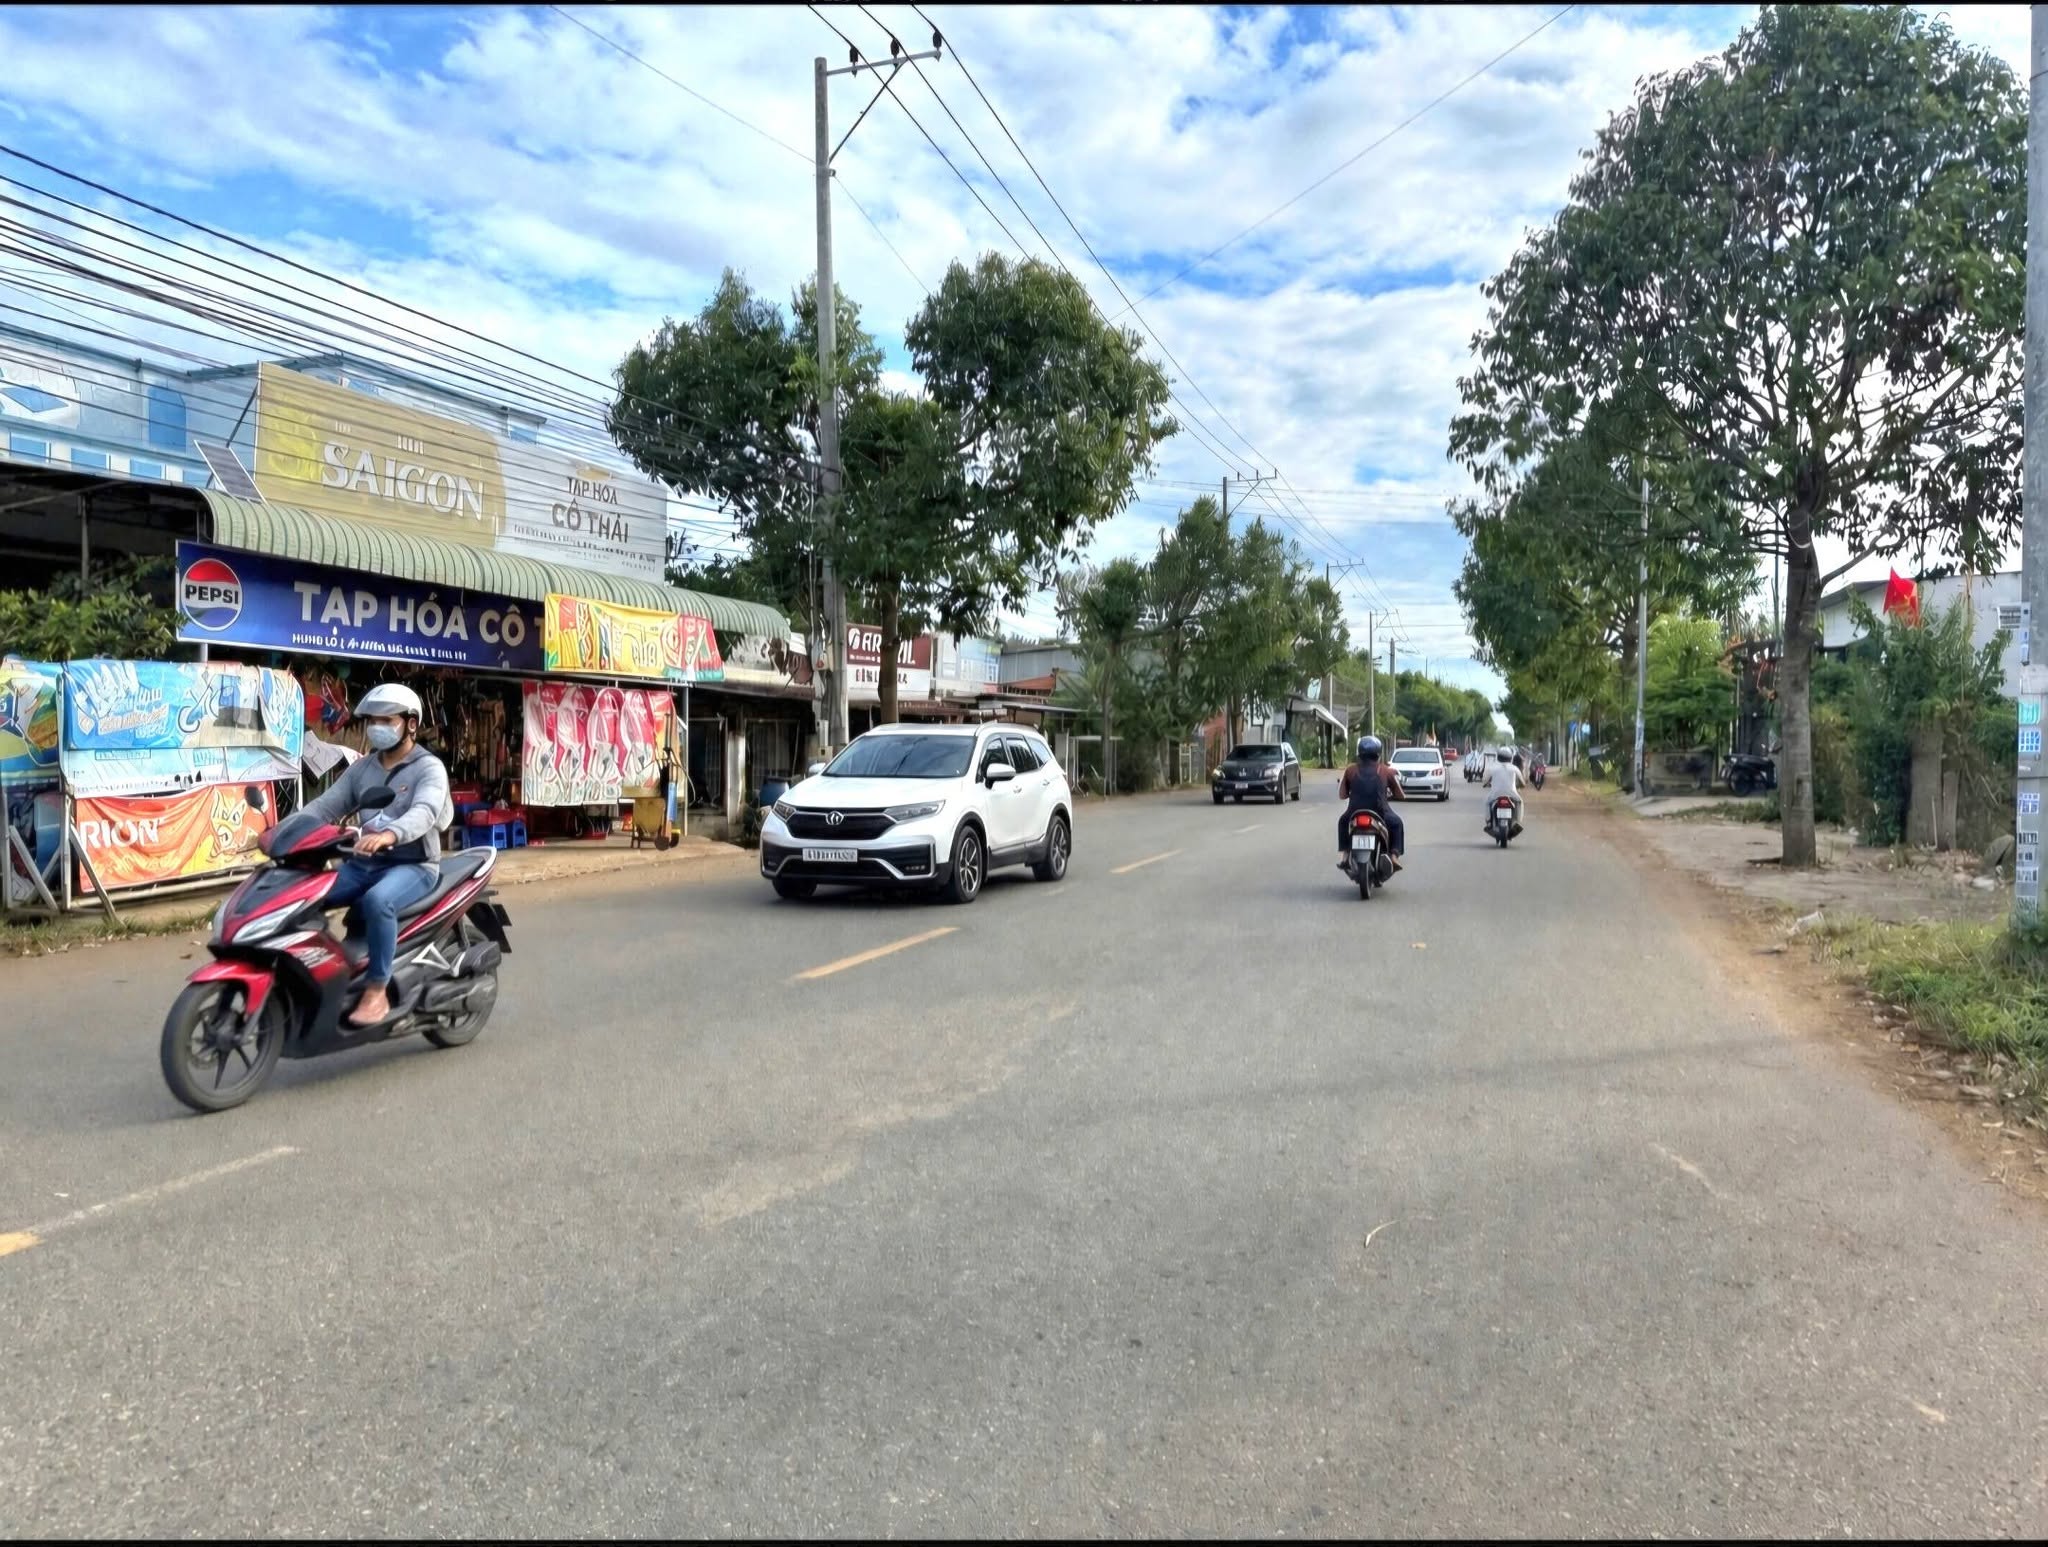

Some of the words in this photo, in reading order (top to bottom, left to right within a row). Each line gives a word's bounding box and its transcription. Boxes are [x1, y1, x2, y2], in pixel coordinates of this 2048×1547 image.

[322, 440, 483, 521] SAIGON
[185, 583, 239, 605] PEPSI
[389, 591, 469, 641] HÓA
[479, 604, 526, 647] CÔ
